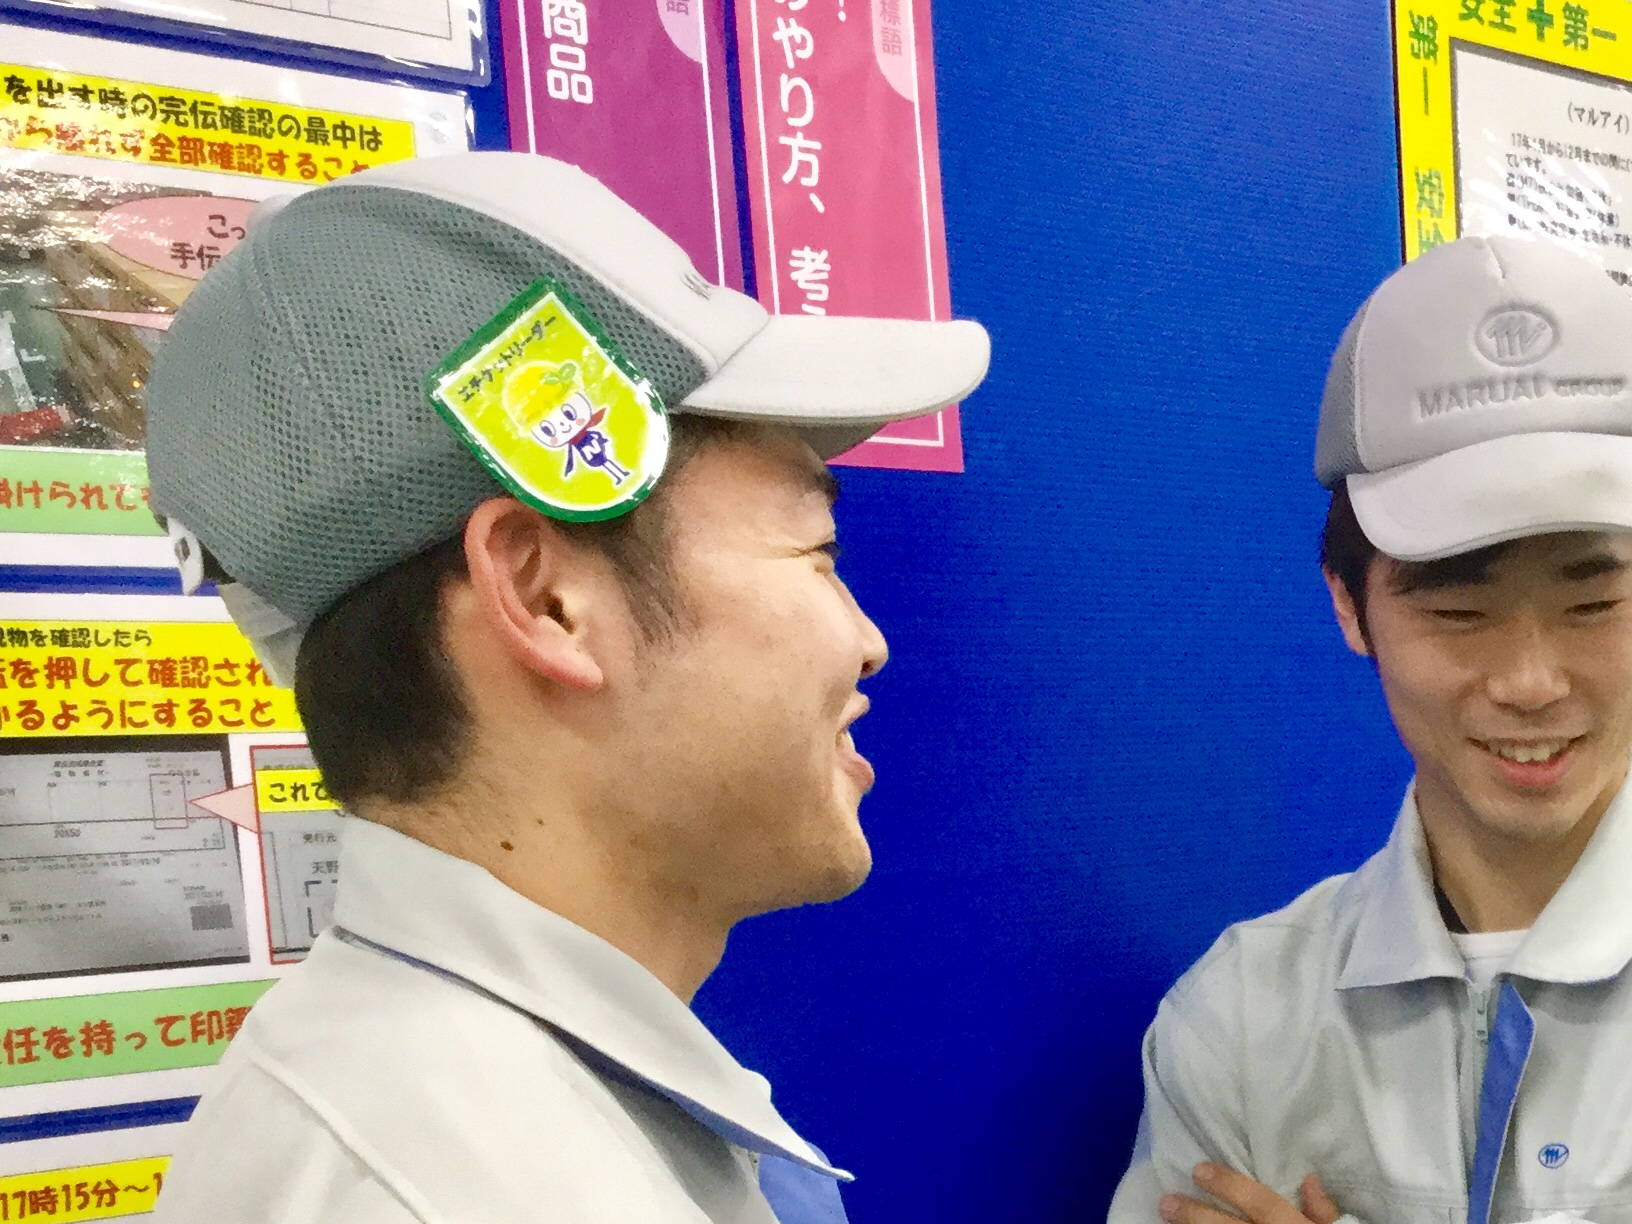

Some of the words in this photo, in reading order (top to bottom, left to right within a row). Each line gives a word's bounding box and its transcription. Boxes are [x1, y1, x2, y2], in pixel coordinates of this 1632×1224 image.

[541, 0, 594, 105] 商品
[771, 0, 832, 316] やり方、考
[0, 1006, 253, 1065] 任を持って印
